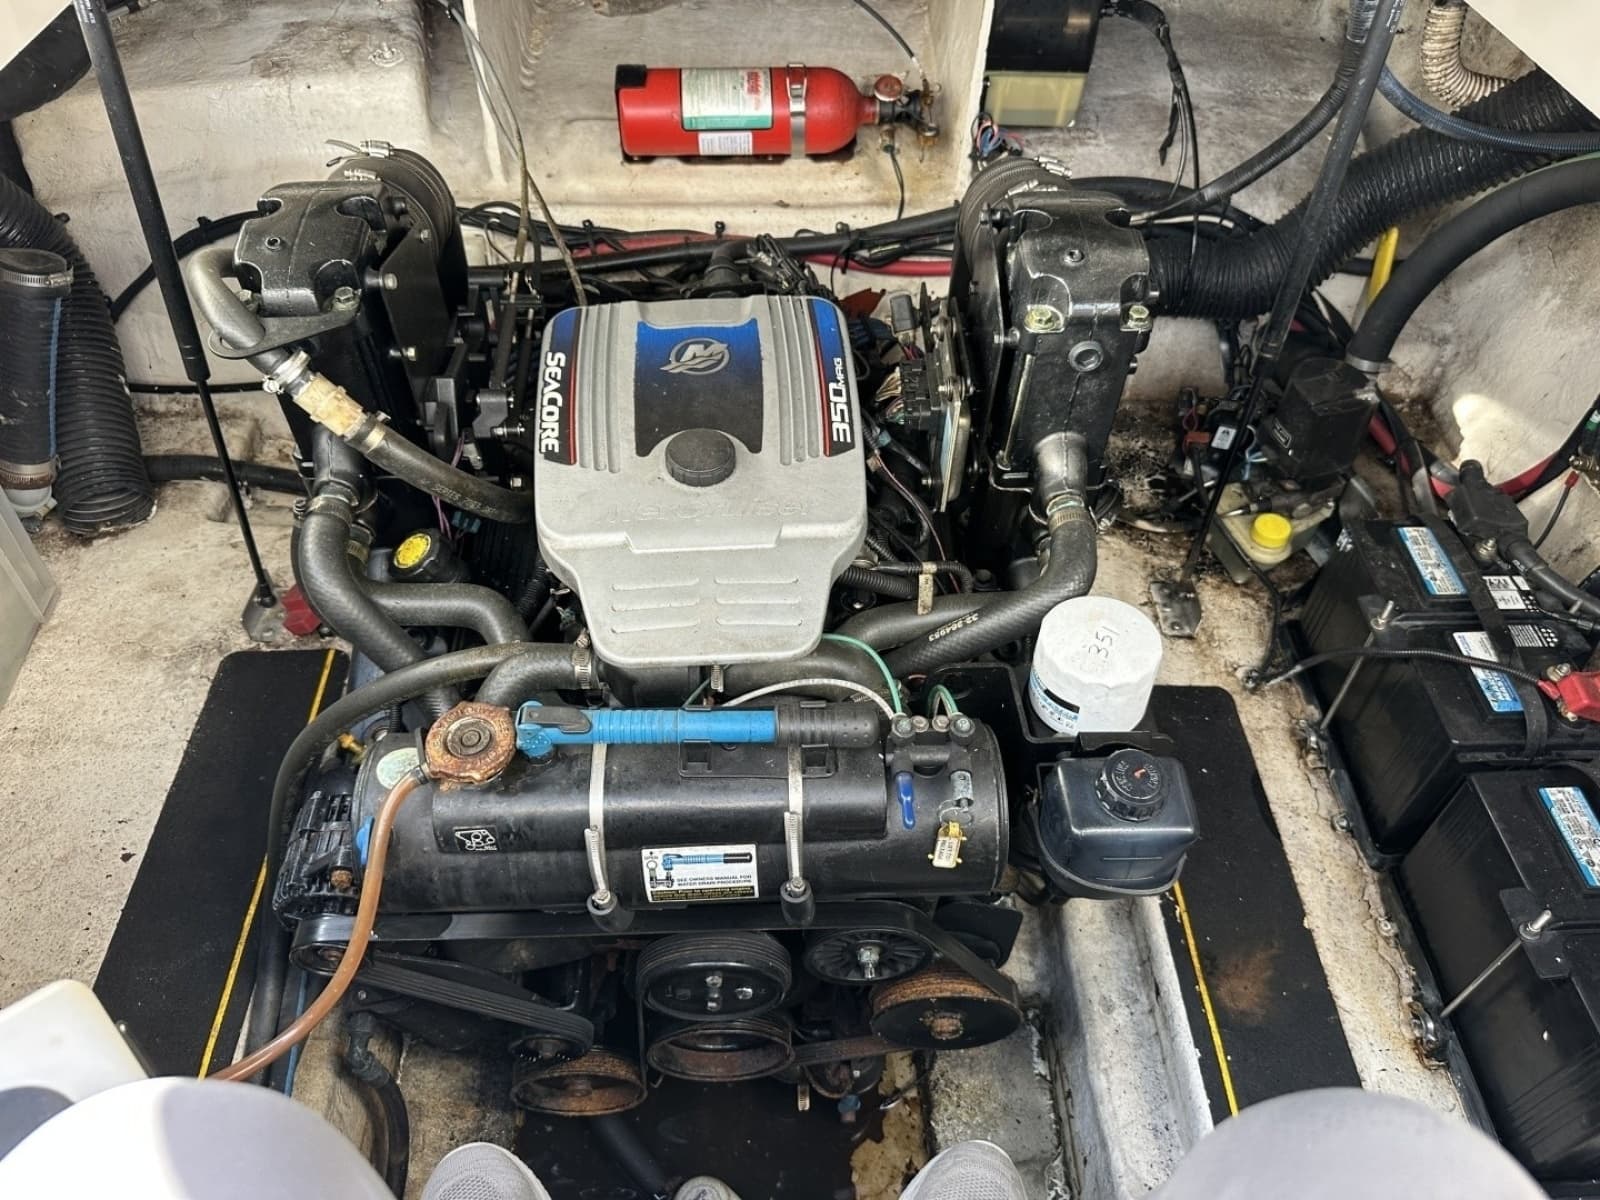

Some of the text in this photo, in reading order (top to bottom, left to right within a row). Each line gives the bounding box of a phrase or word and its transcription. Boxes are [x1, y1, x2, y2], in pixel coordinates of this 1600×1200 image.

[829, 357, 852, 444] 350 MAG
[1088, 626, 1120, 659] 351
